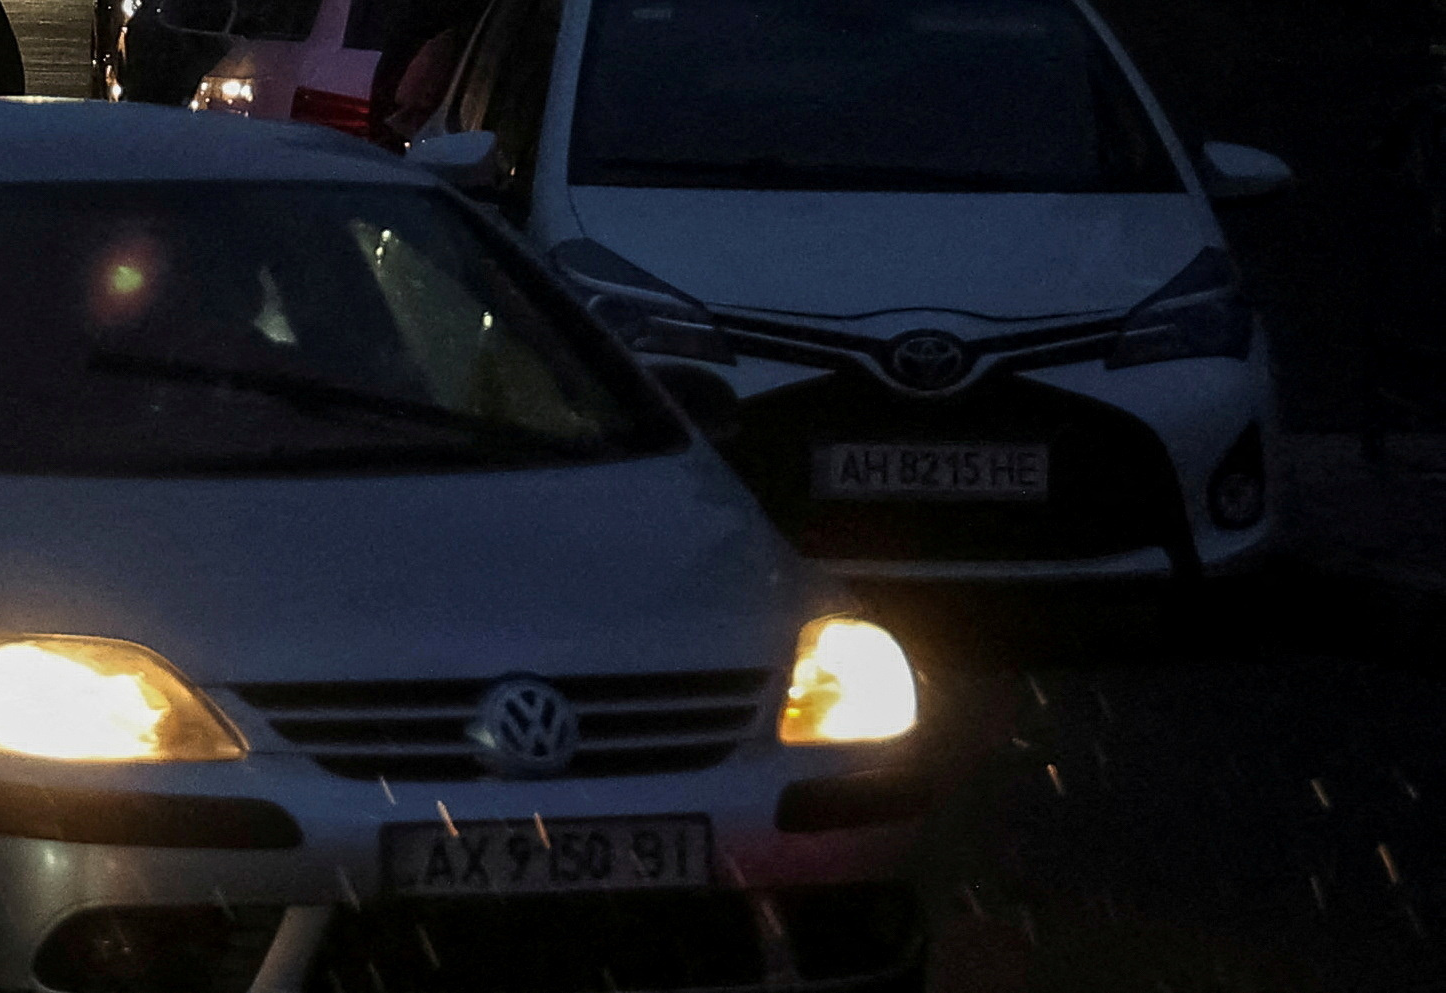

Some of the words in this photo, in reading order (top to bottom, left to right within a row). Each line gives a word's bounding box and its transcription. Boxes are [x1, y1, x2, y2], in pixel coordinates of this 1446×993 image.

[840, 450, 889, 484] AH
[900, 450, 981, 485] 8215
[990, 451, 1041, 486] HE
[426, 833, 490, 885] AX
